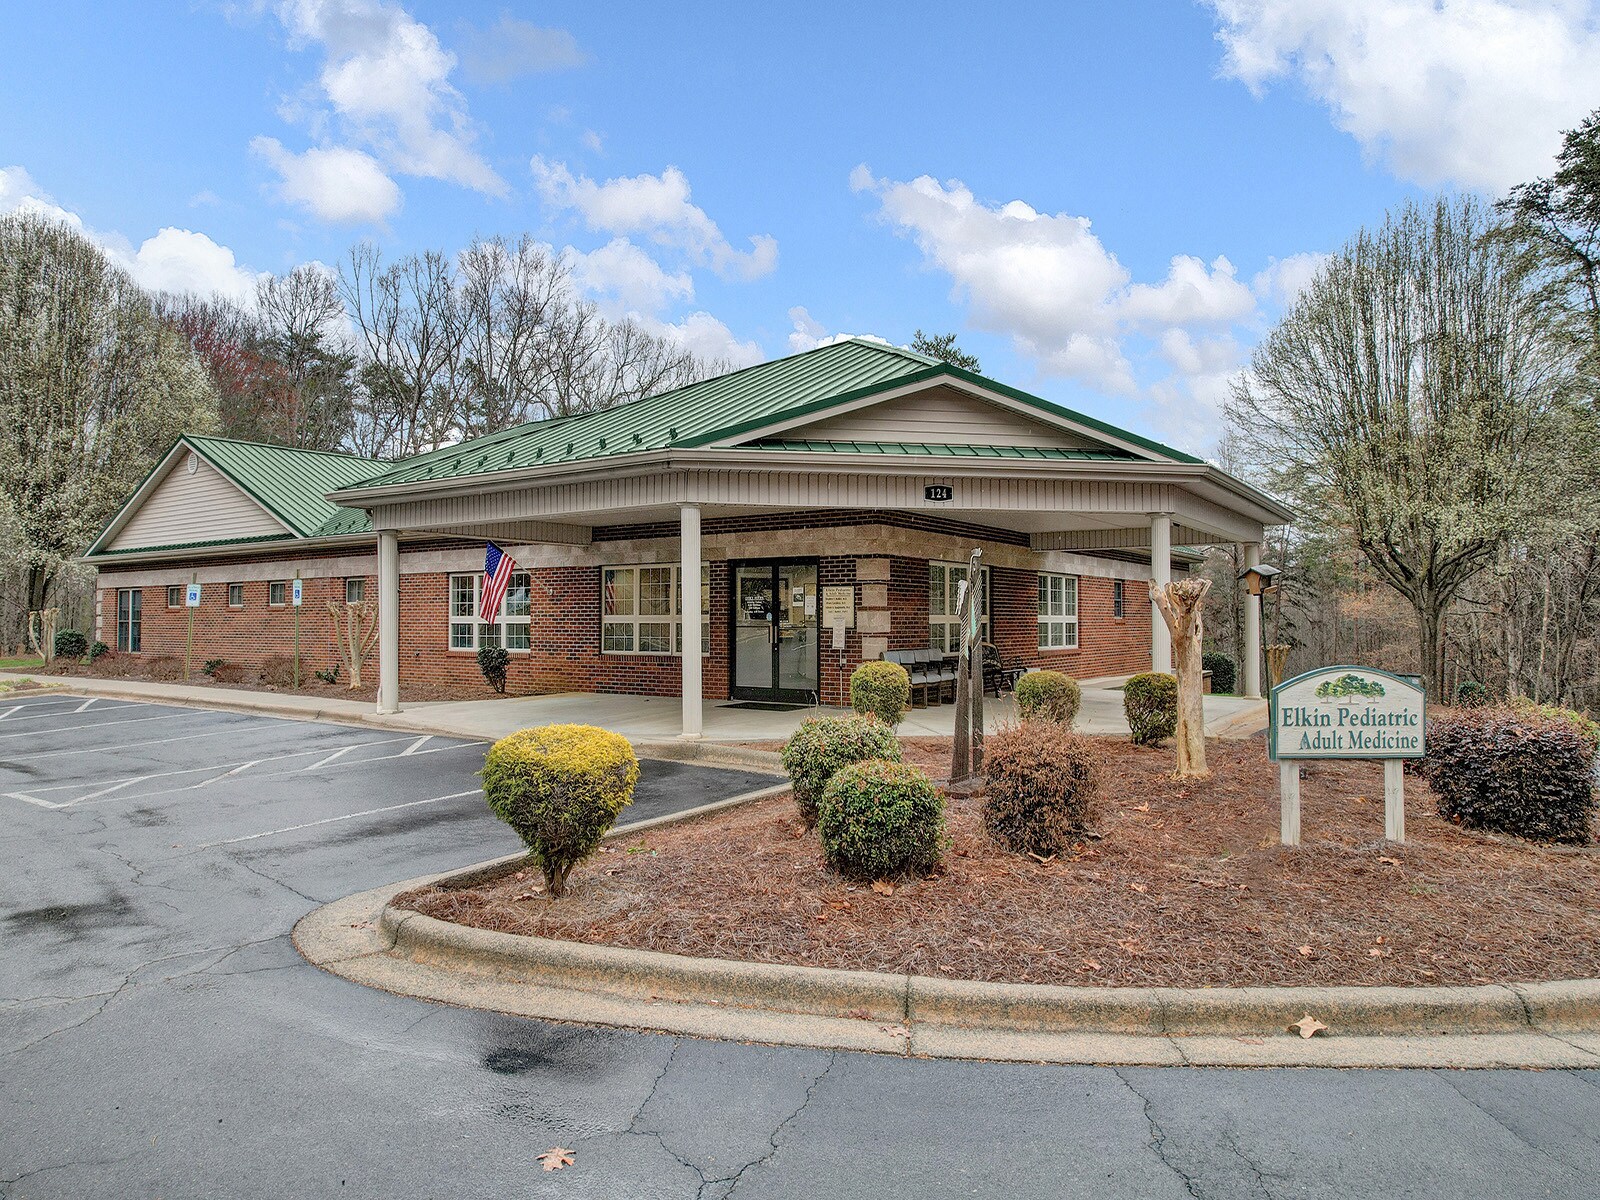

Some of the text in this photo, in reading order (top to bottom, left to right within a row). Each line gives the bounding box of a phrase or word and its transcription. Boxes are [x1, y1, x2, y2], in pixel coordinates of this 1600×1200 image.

[930, 488, 947, 499] 124
[1281, 706, 1418, 727] Elkin Pediatric
[1299, 729, 1419, 750] Adult Medicine
